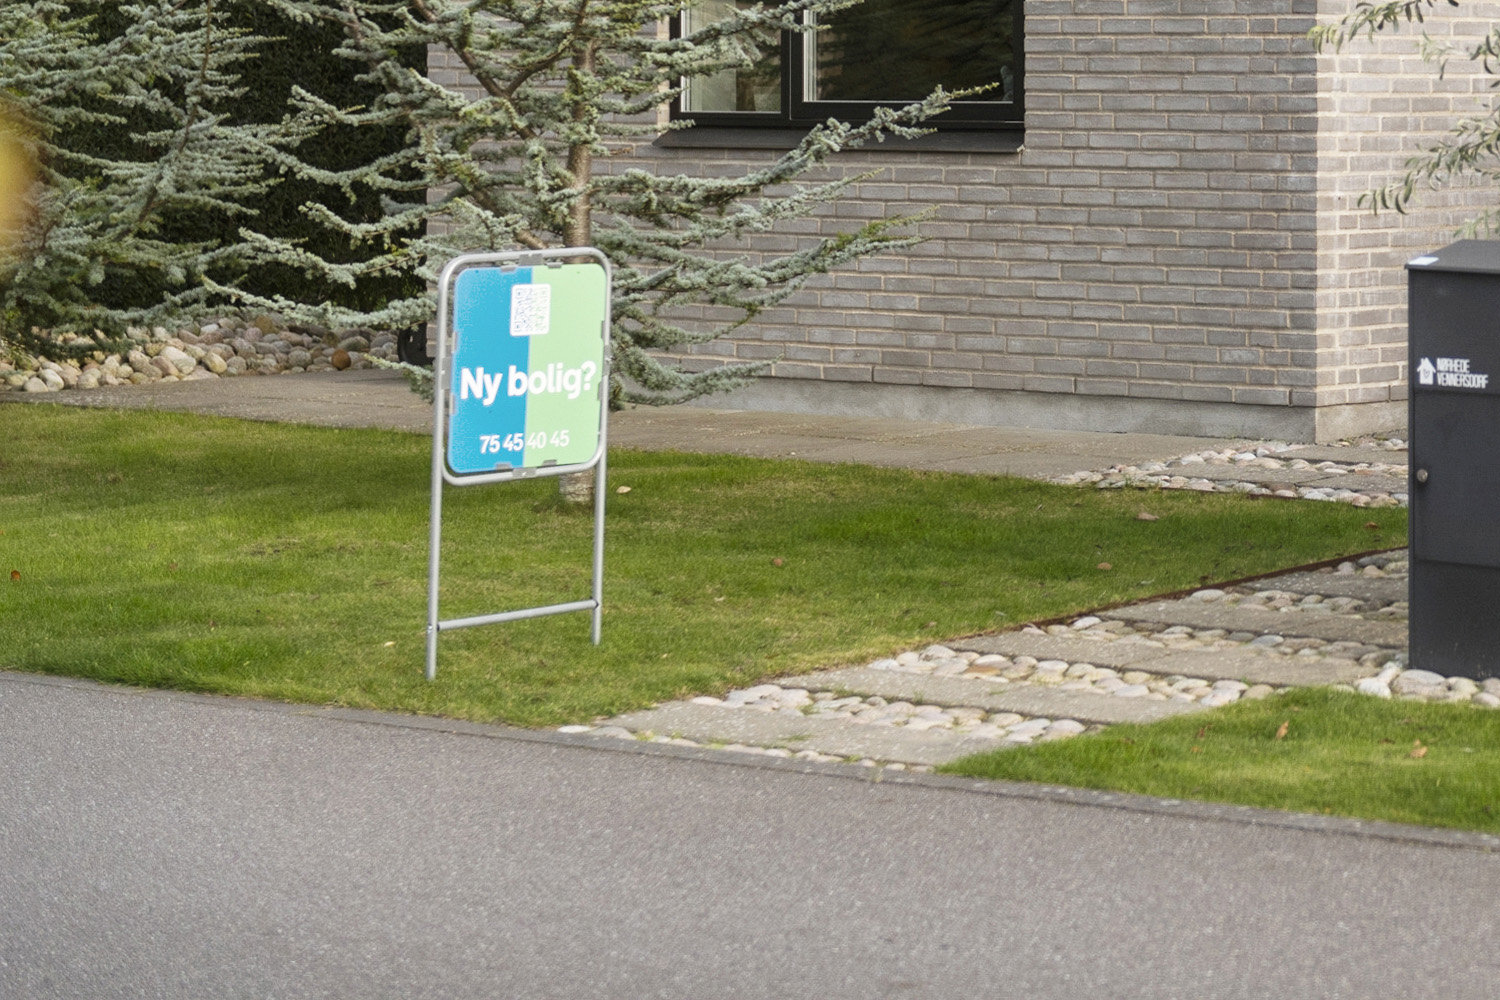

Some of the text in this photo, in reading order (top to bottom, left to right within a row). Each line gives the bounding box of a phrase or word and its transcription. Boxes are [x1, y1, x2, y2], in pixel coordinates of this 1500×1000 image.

[460, 360, 597, 406] Ny bolig?
[479, 430, 570, 454] 75 45 40 45
